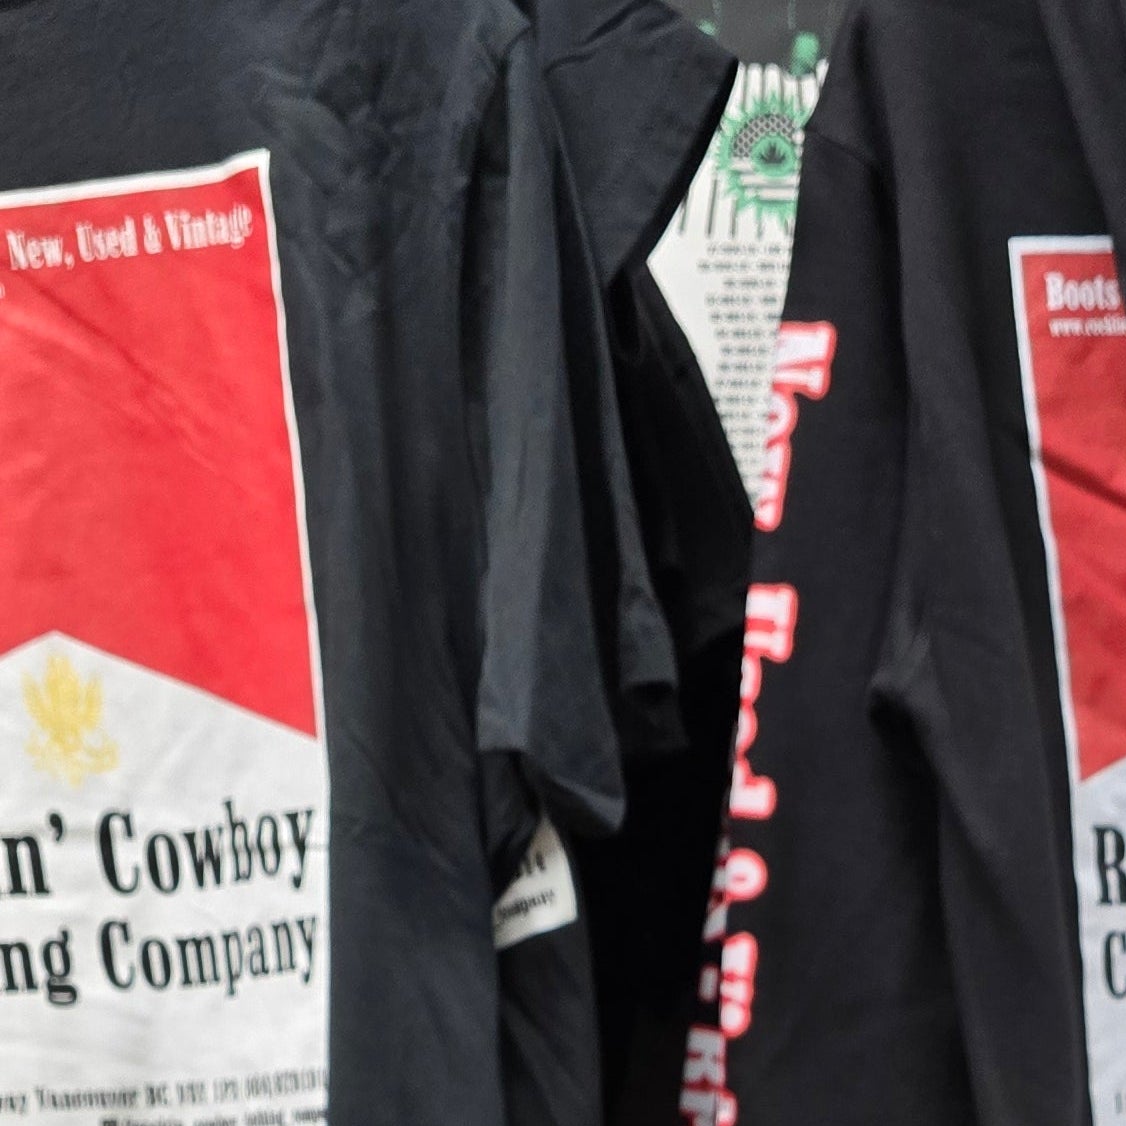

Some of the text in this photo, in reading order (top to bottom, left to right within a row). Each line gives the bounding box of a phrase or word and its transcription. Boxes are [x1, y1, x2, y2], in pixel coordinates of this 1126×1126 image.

[6, 203, 254, 271] New, Used & Vintage
[1044, 271, 1120, 312] Boots
[99, 796, 316, 895] Cowboy
[101, 914, 320, 997] Company
